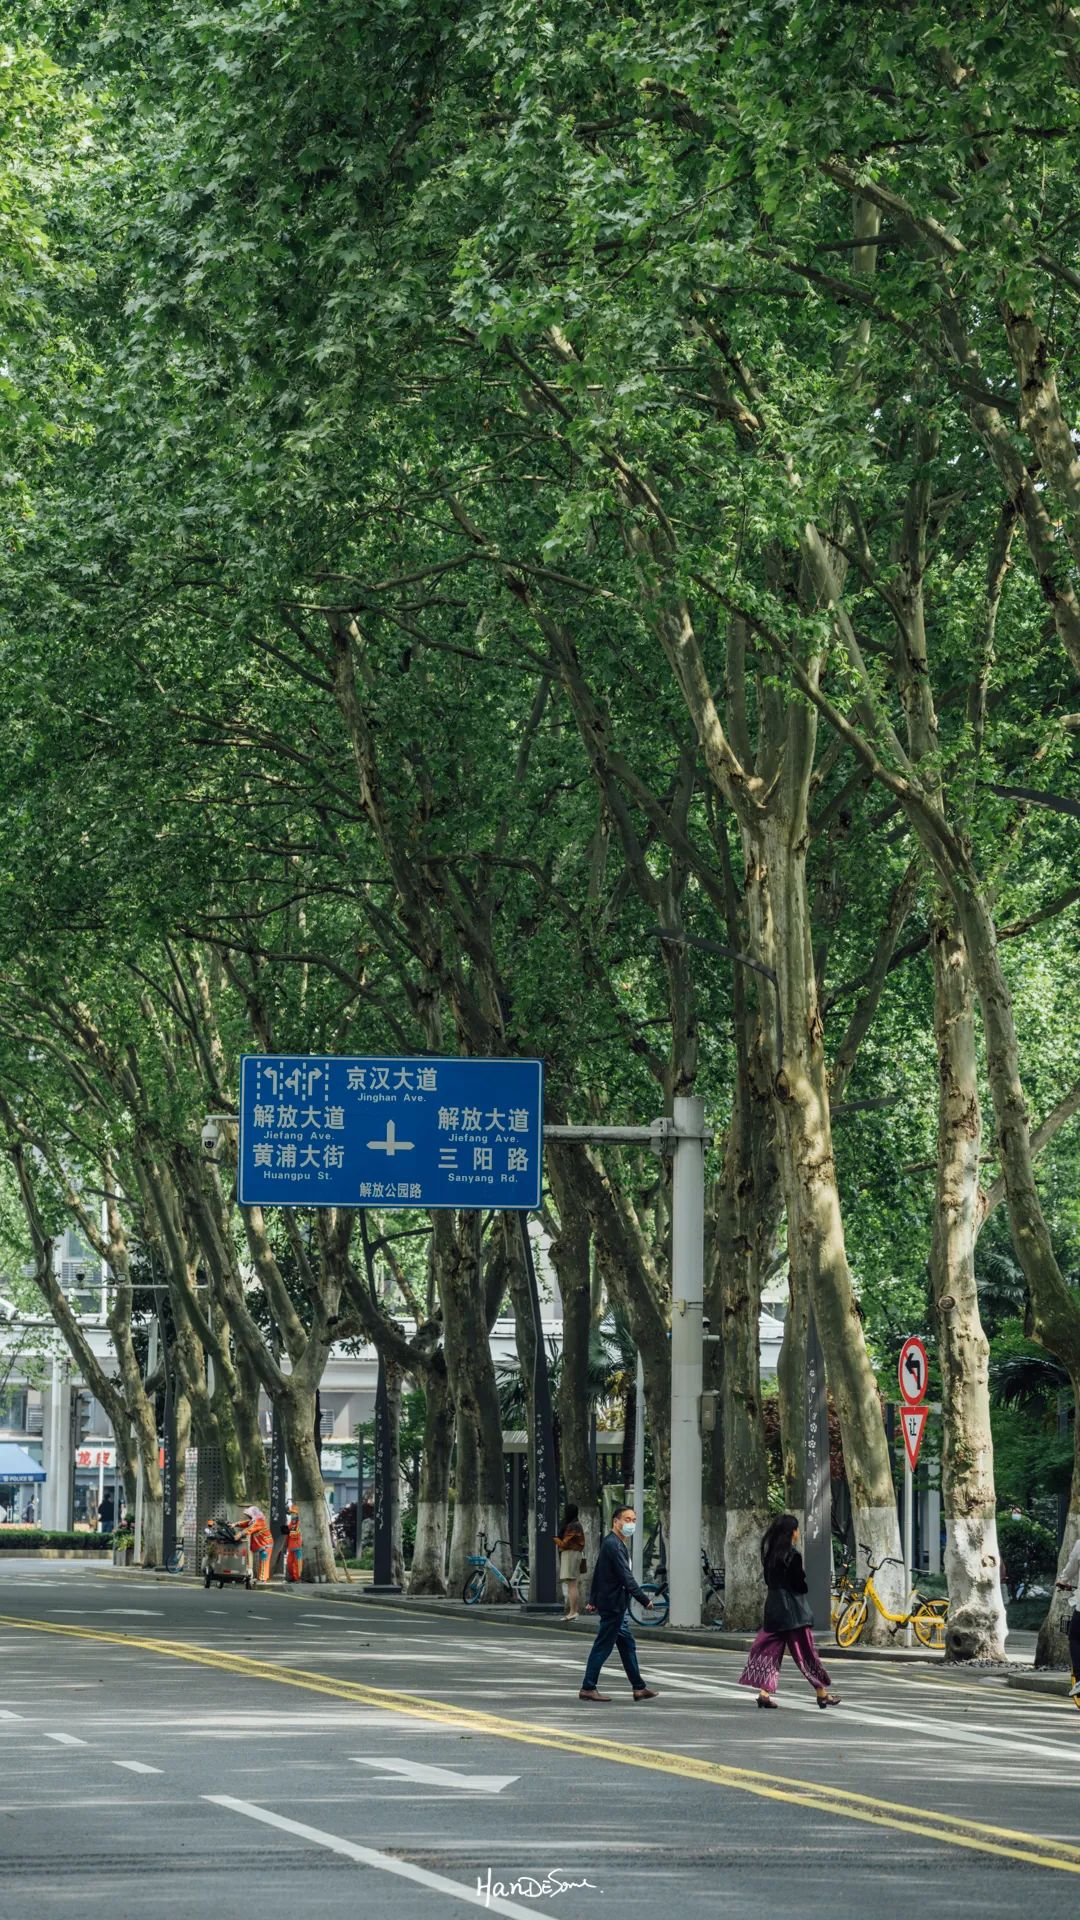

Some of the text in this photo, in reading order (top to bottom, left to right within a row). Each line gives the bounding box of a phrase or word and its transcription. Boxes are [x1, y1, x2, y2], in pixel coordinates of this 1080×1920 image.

[347, 1066, 437, 1091] 京汉大道
[358, 1093, 426, 1102] Jinghan Ave.
[254, 1104, 344, 1129] 解放大道
[438, 1107, 529, 1132] 解放大道
[264, 1131, 335, 1140] Jiefang Ave.
[449, 1134, 519, 1143] Jiefang Ave.
[253, 1143, 344, 1168] 黄浦大街
[438, 1147, 528, 1171] 三阳路
[264, 1171, 333, 1180] Huangpu St.
[448, 1173, 518, 1183] Sanyang Rd.
[360, 1183, 421, 1198] 解放公园路
[908, 1418, 917, 1436] 让
